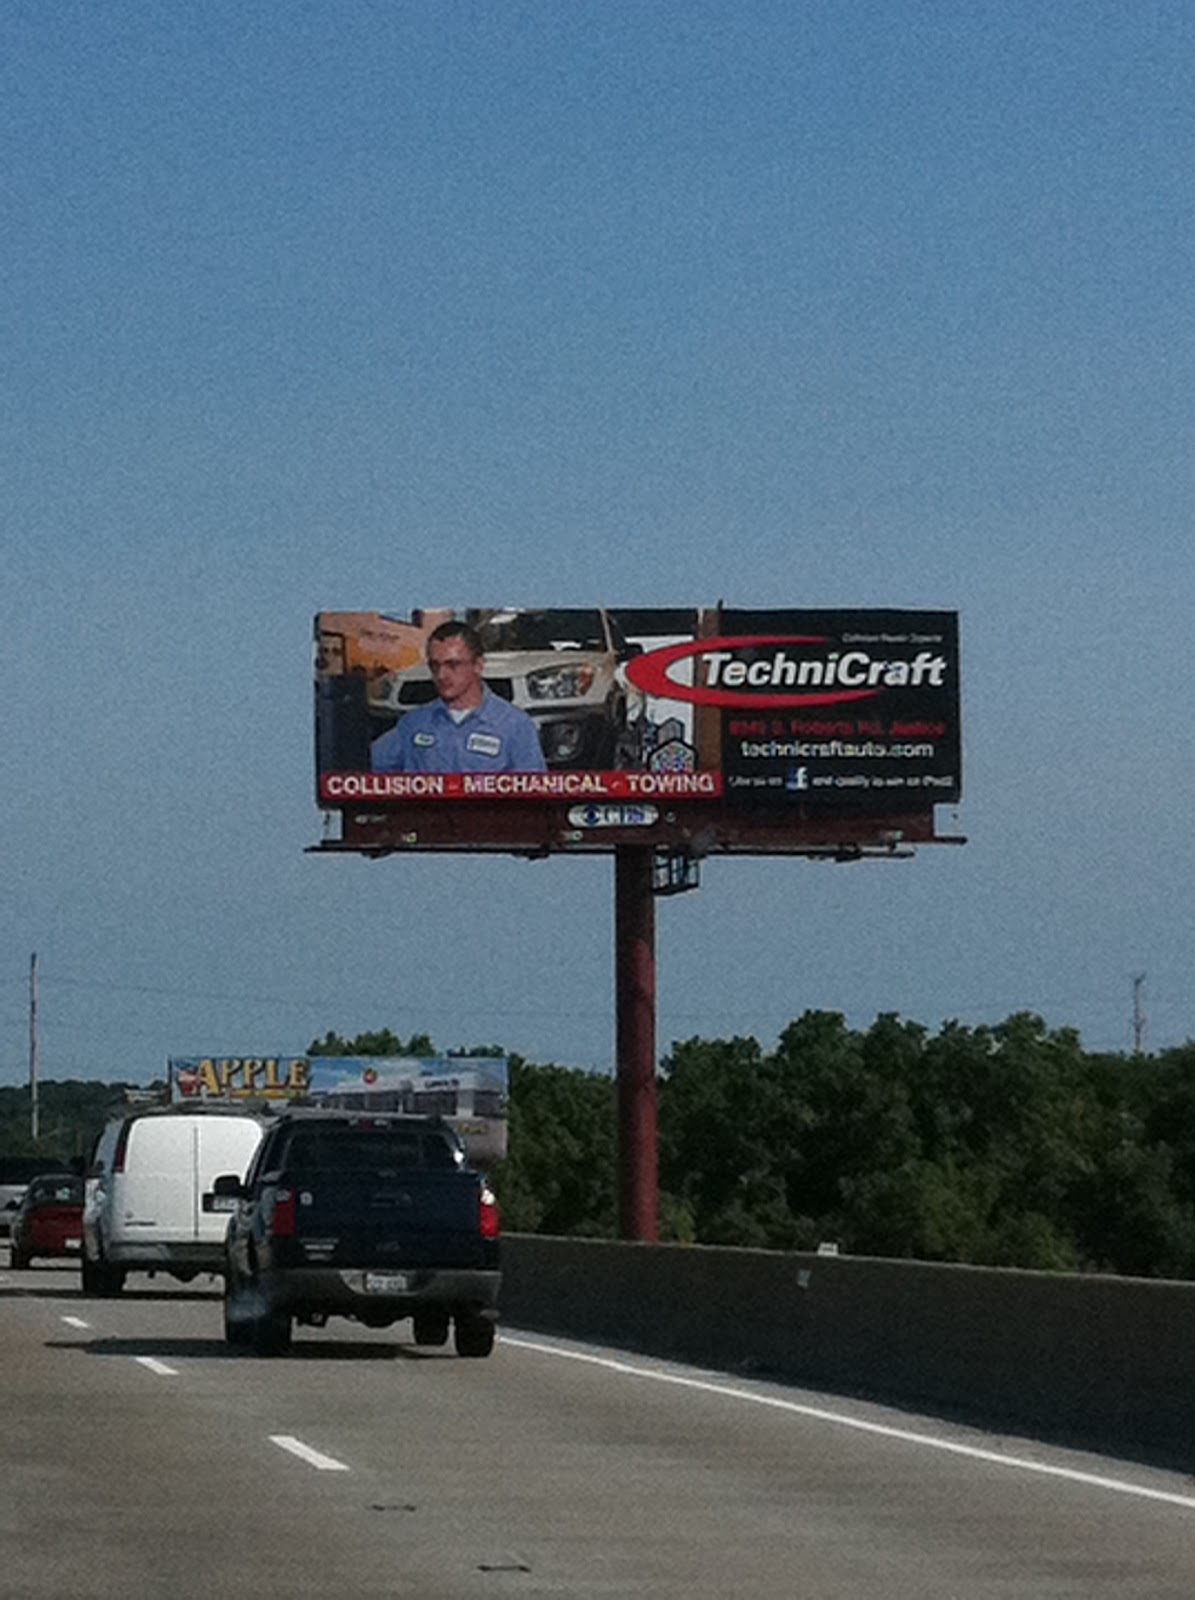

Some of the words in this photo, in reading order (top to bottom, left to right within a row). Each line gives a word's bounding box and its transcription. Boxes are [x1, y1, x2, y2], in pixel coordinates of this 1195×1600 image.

[702, 652, 946, 686] TechniCraft
[741, 741, 934, 757] technicraftauto.com
[327, 776, 444, 795] COLLISION
[463, 775, 608, 793] MECHANICAL
[626, 774, 715, 793] TOWING
[198, 1058, 310, 1095] APPLE
